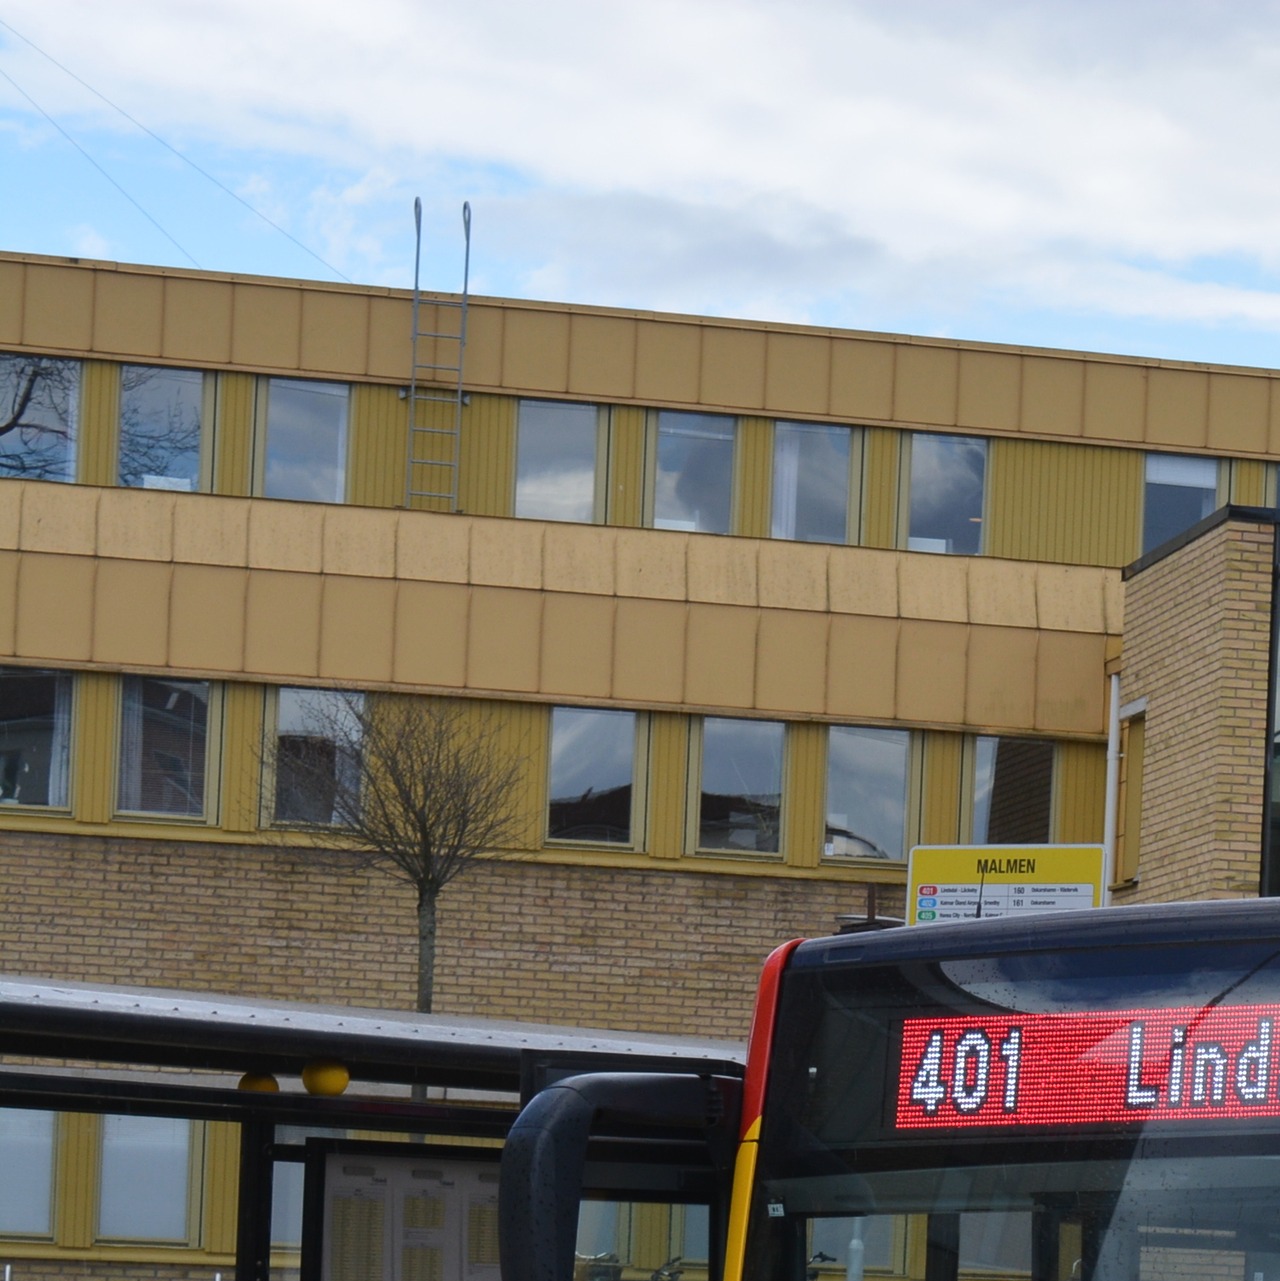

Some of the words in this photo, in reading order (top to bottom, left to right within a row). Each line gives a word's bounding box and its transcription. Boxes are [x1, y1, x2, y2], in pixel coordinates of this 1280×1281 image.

[977, 858, 1036, 874] MALMEN
[921, 887, 934, 895] 401
[1013, 887, 1025, 895] 160
[1013, 899, 1024, 907] 161
[911, 1027, 1021, 1112] 401
